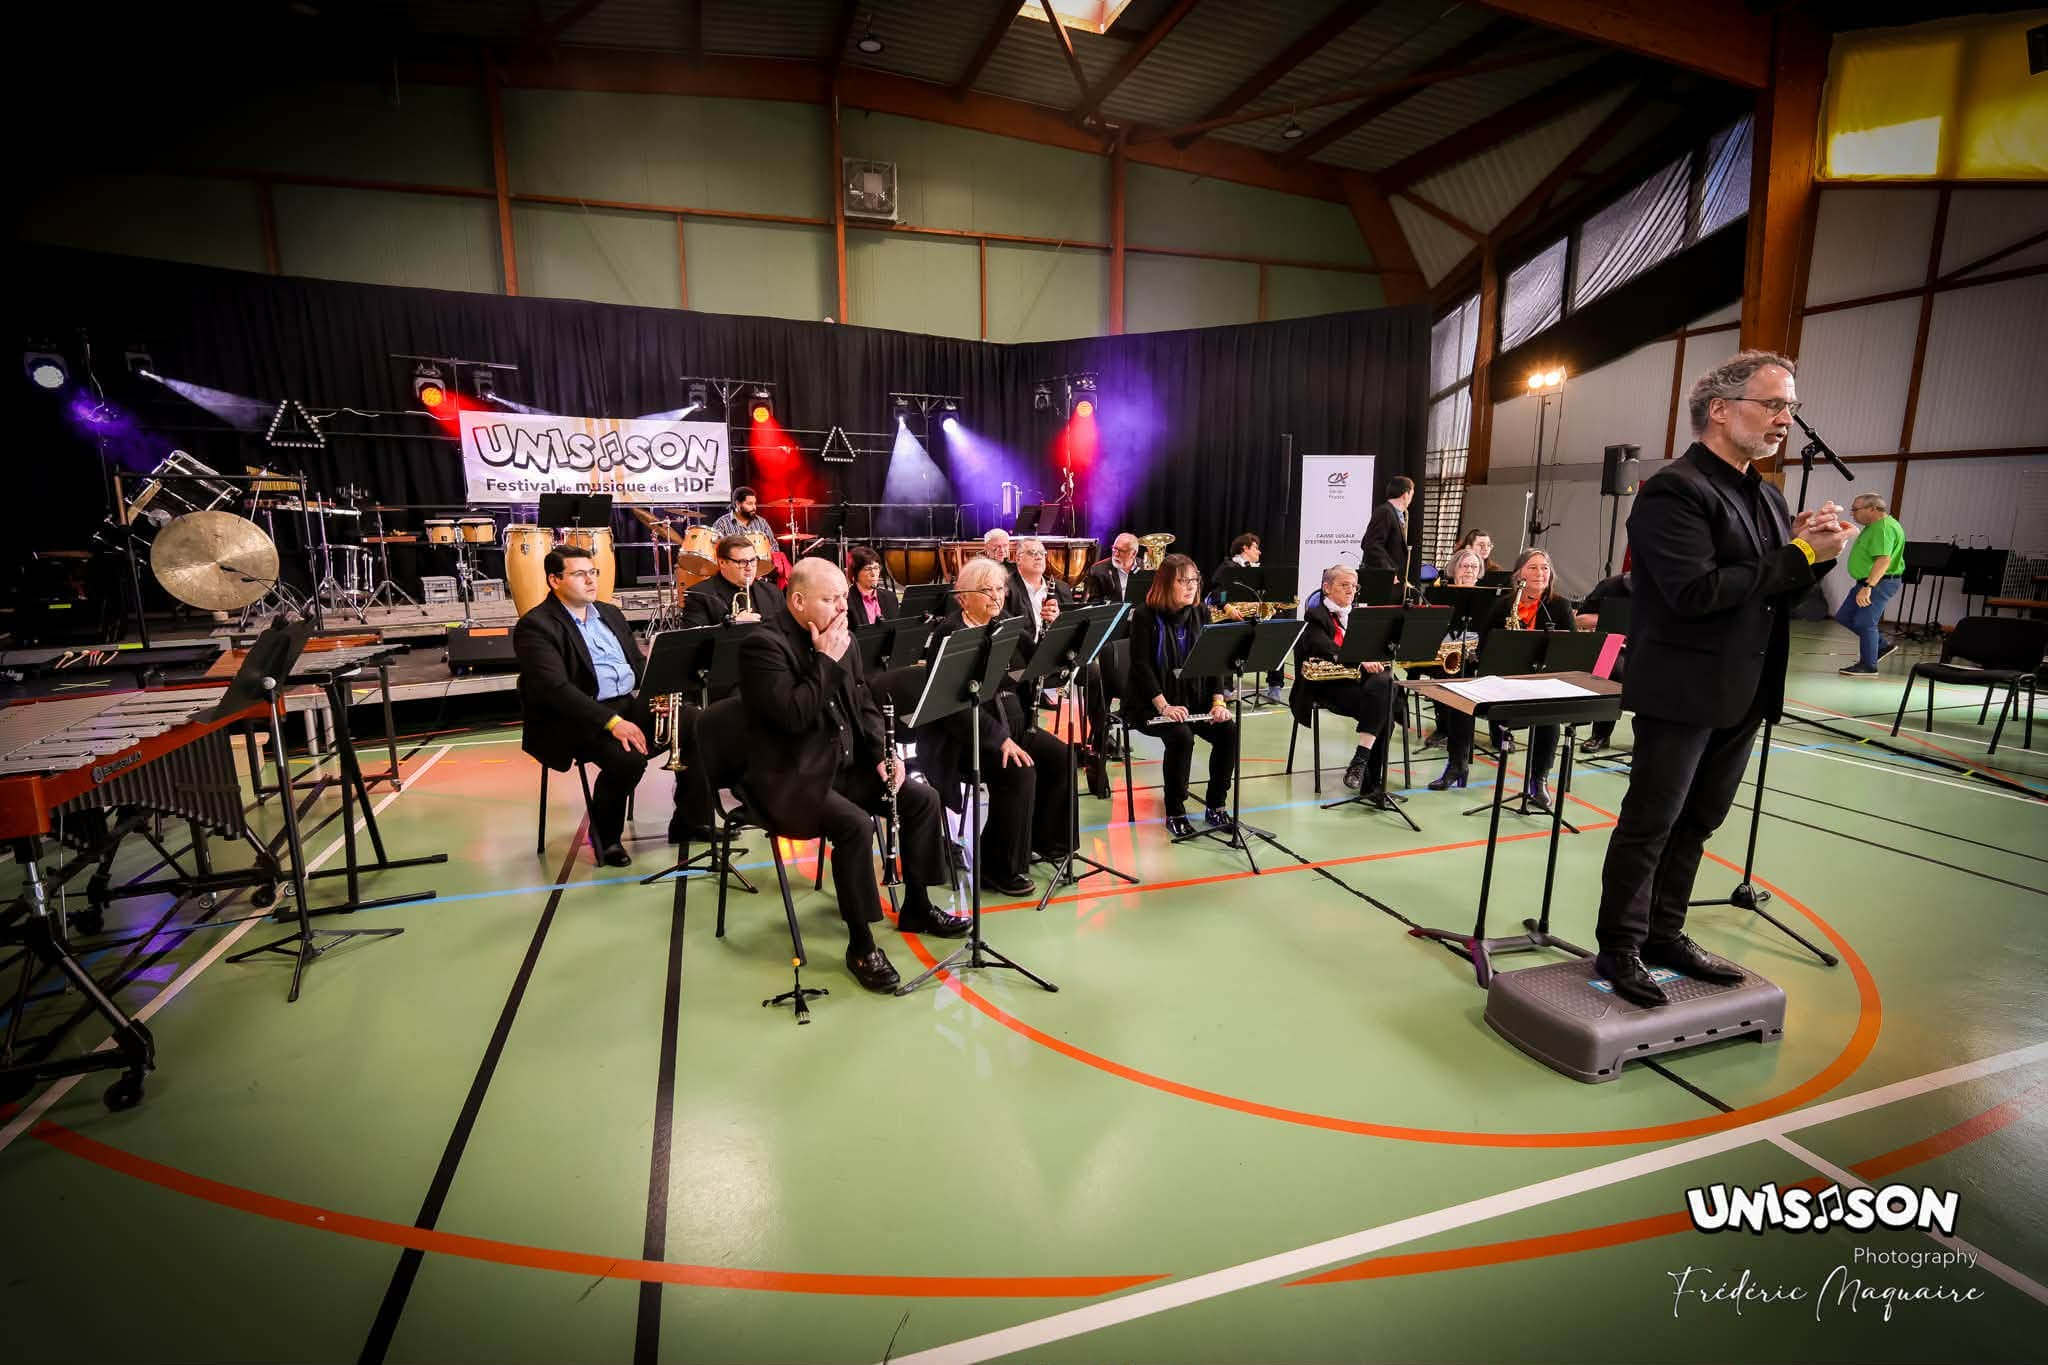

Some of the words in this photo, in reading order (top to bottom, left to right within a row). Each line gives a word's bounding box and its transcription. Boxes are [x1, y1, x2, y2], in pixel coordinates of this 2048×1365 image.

[486, 478, 556, 492] Festival
[575, 479, 646, 495] musique
[649, 482, 669, 492] des
[675, 477, 715, 492] HDF
